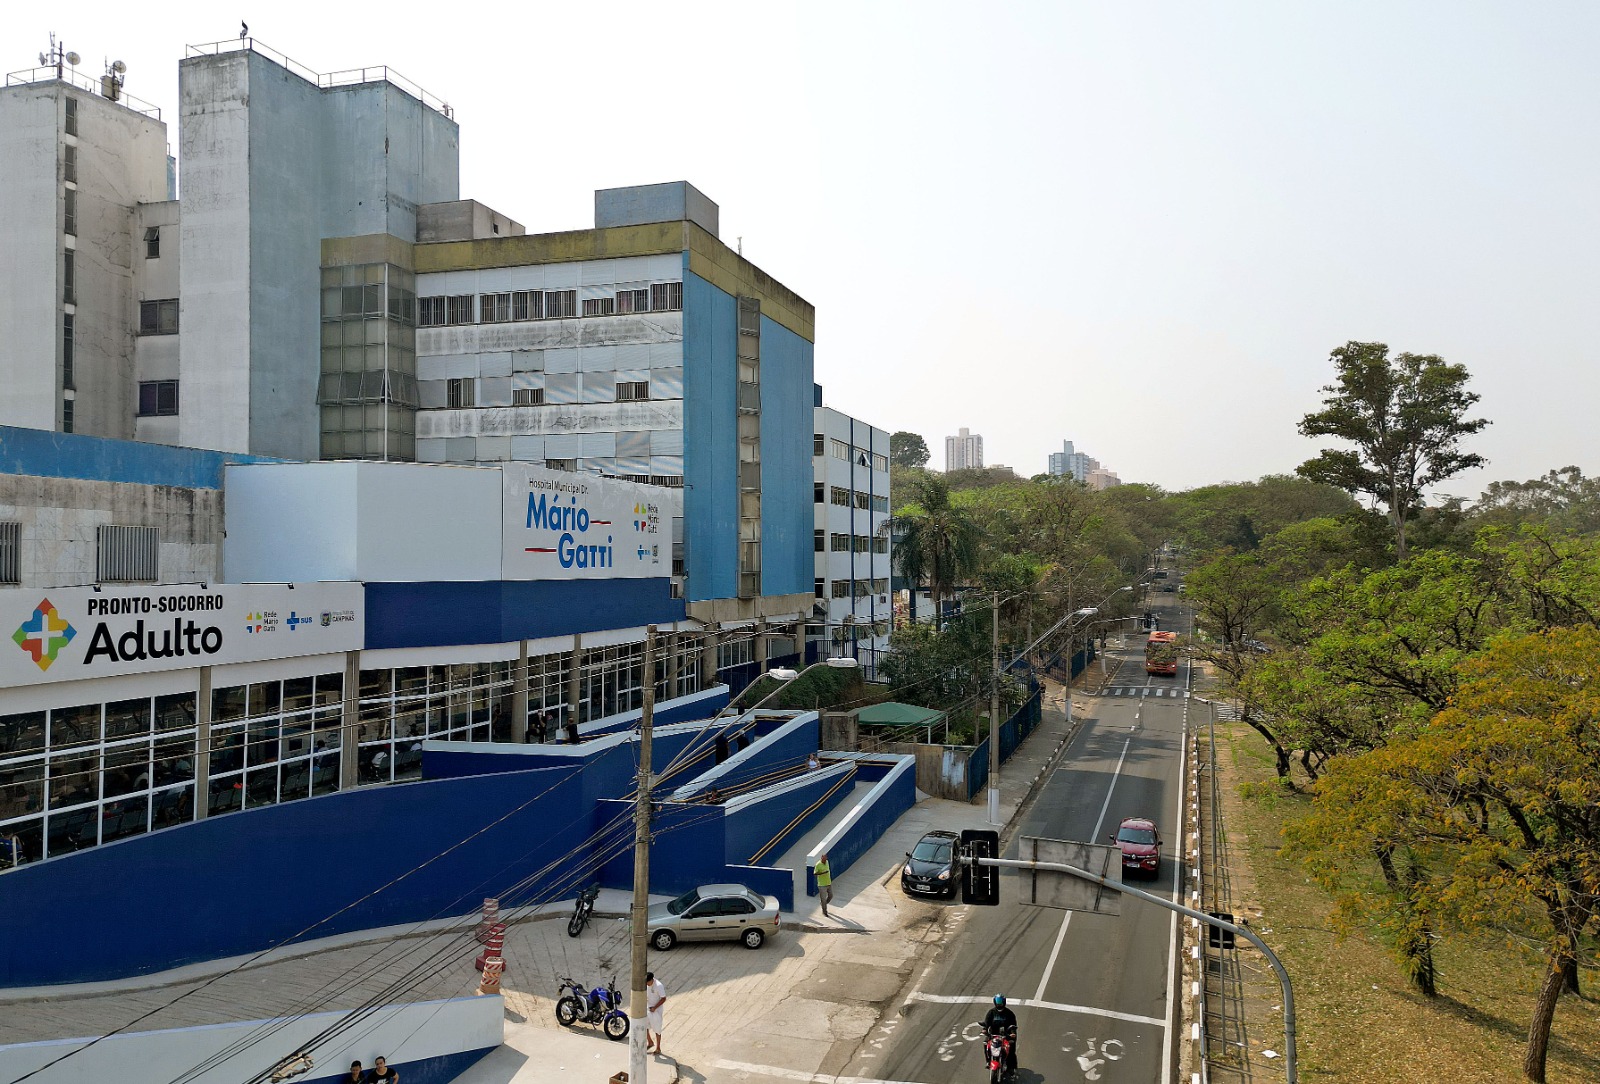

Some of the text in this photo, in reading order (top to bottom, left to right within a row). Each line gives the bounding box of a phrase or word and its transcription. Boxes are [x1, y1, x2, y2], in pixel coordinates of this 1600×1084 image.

[529, 478, 589, 495] Hospital Municipal Dr.
[526, 492, 589, 532] Mário
[558, 532, 612, 568] Gatti
[88, 595, 223, 615] PRONTO-SOCORRO
[83, 617, 223, 664] Adulto
